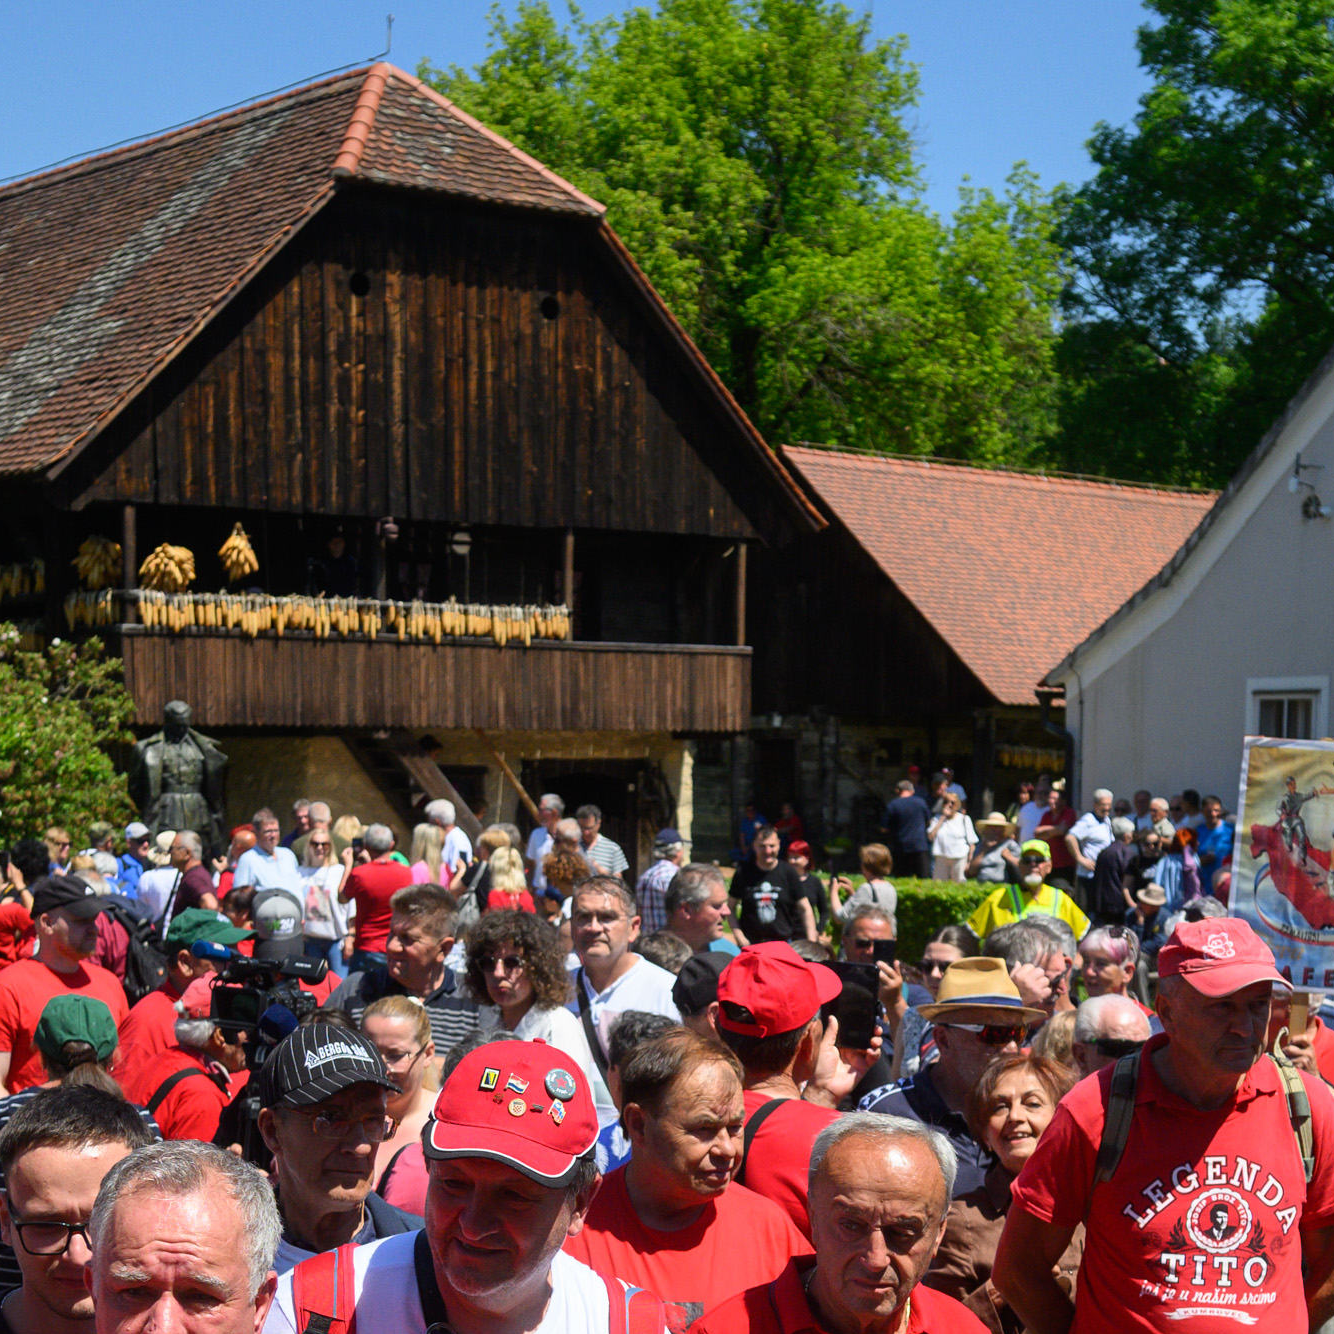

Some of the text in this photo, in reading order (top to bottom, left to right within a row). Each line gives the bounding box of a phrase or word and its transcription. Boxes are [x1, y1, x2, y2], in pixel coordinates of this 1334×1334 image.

[1123, 1155, 1297, 1235] LEGENDA
[1192, 1193, 1247, 1226] JOSIP BROZ TITO
[1160, 1252, 1268, 1288] TITO
[1179, 1289, 1189, 1301] u
[1191, 1288, 1237, 1304] našim
[1183, 1308, 1244, 1318] KUMROVEC
